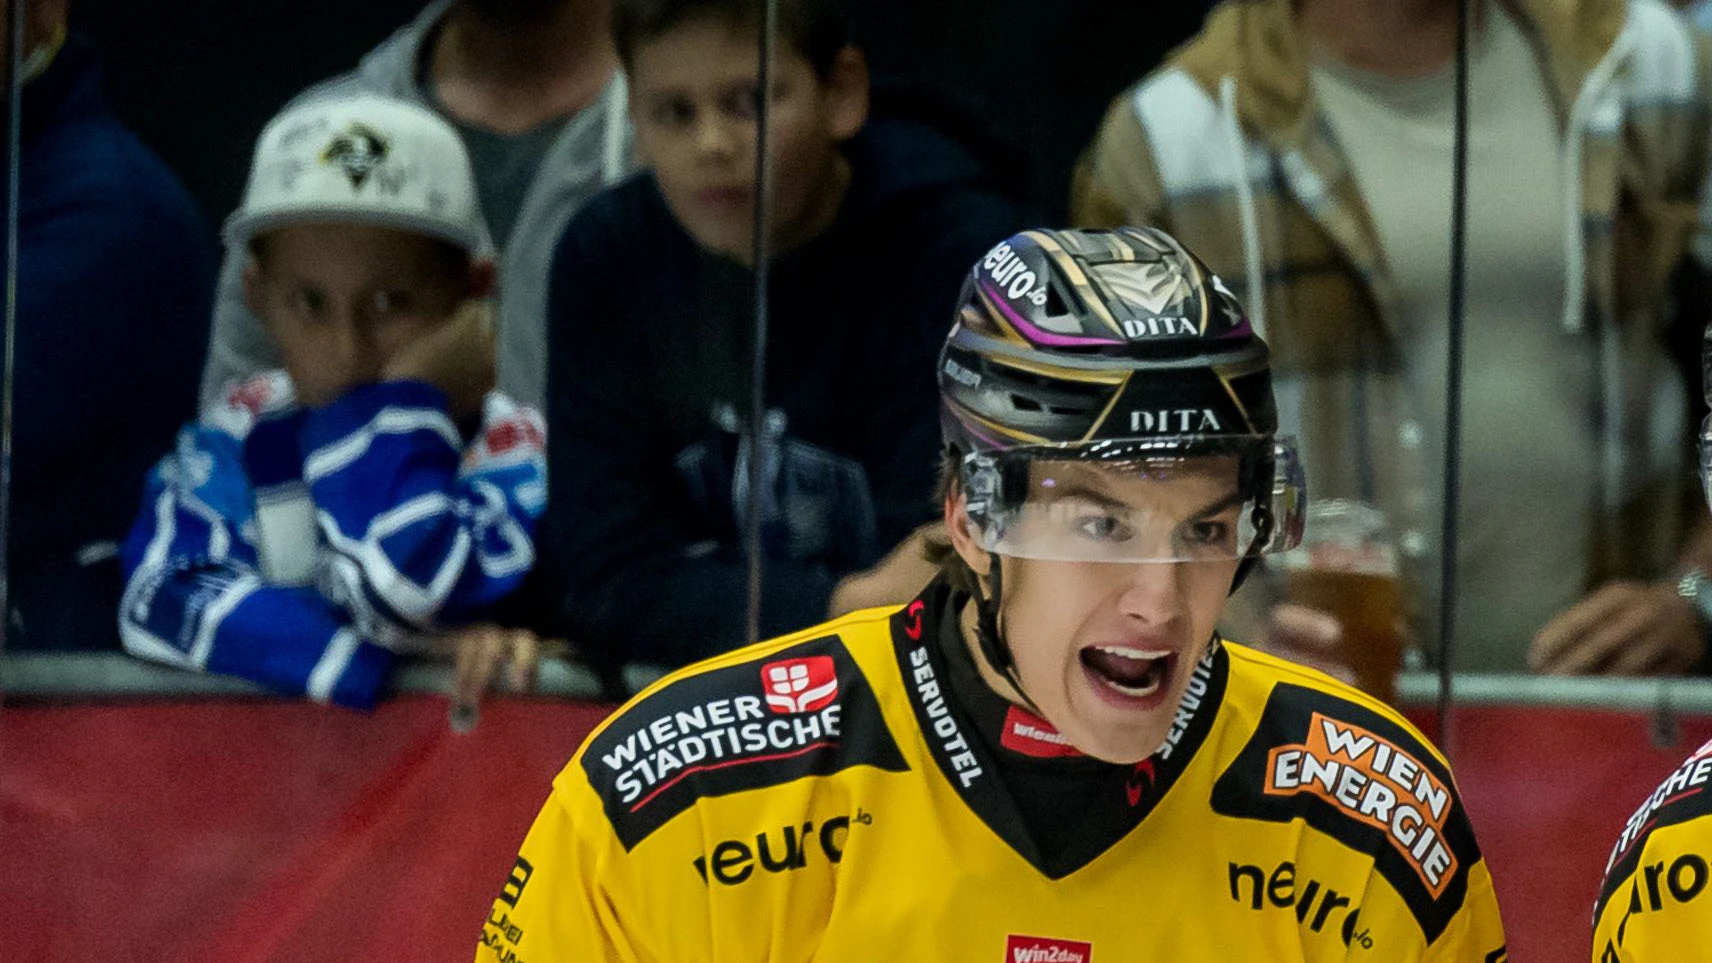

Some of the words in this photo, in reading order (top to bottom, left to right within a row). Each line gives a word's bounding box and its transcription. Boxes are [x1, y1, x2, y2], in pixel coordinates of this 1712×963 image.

[983, 241, 1047, 306] euro.io
[1124, 316, 1198, 338] DITA
[1130, 409, 1221, 432] DITA
[602, 695, 764, 770] WIENER
[615, 704, 841, 803] STÄDTISCHE
[909, 647, 983, 788] SERVOTEL
[1322, 720, 1447, 819] WIEN
[1274, 751, 1452, 887] ENERGIE
